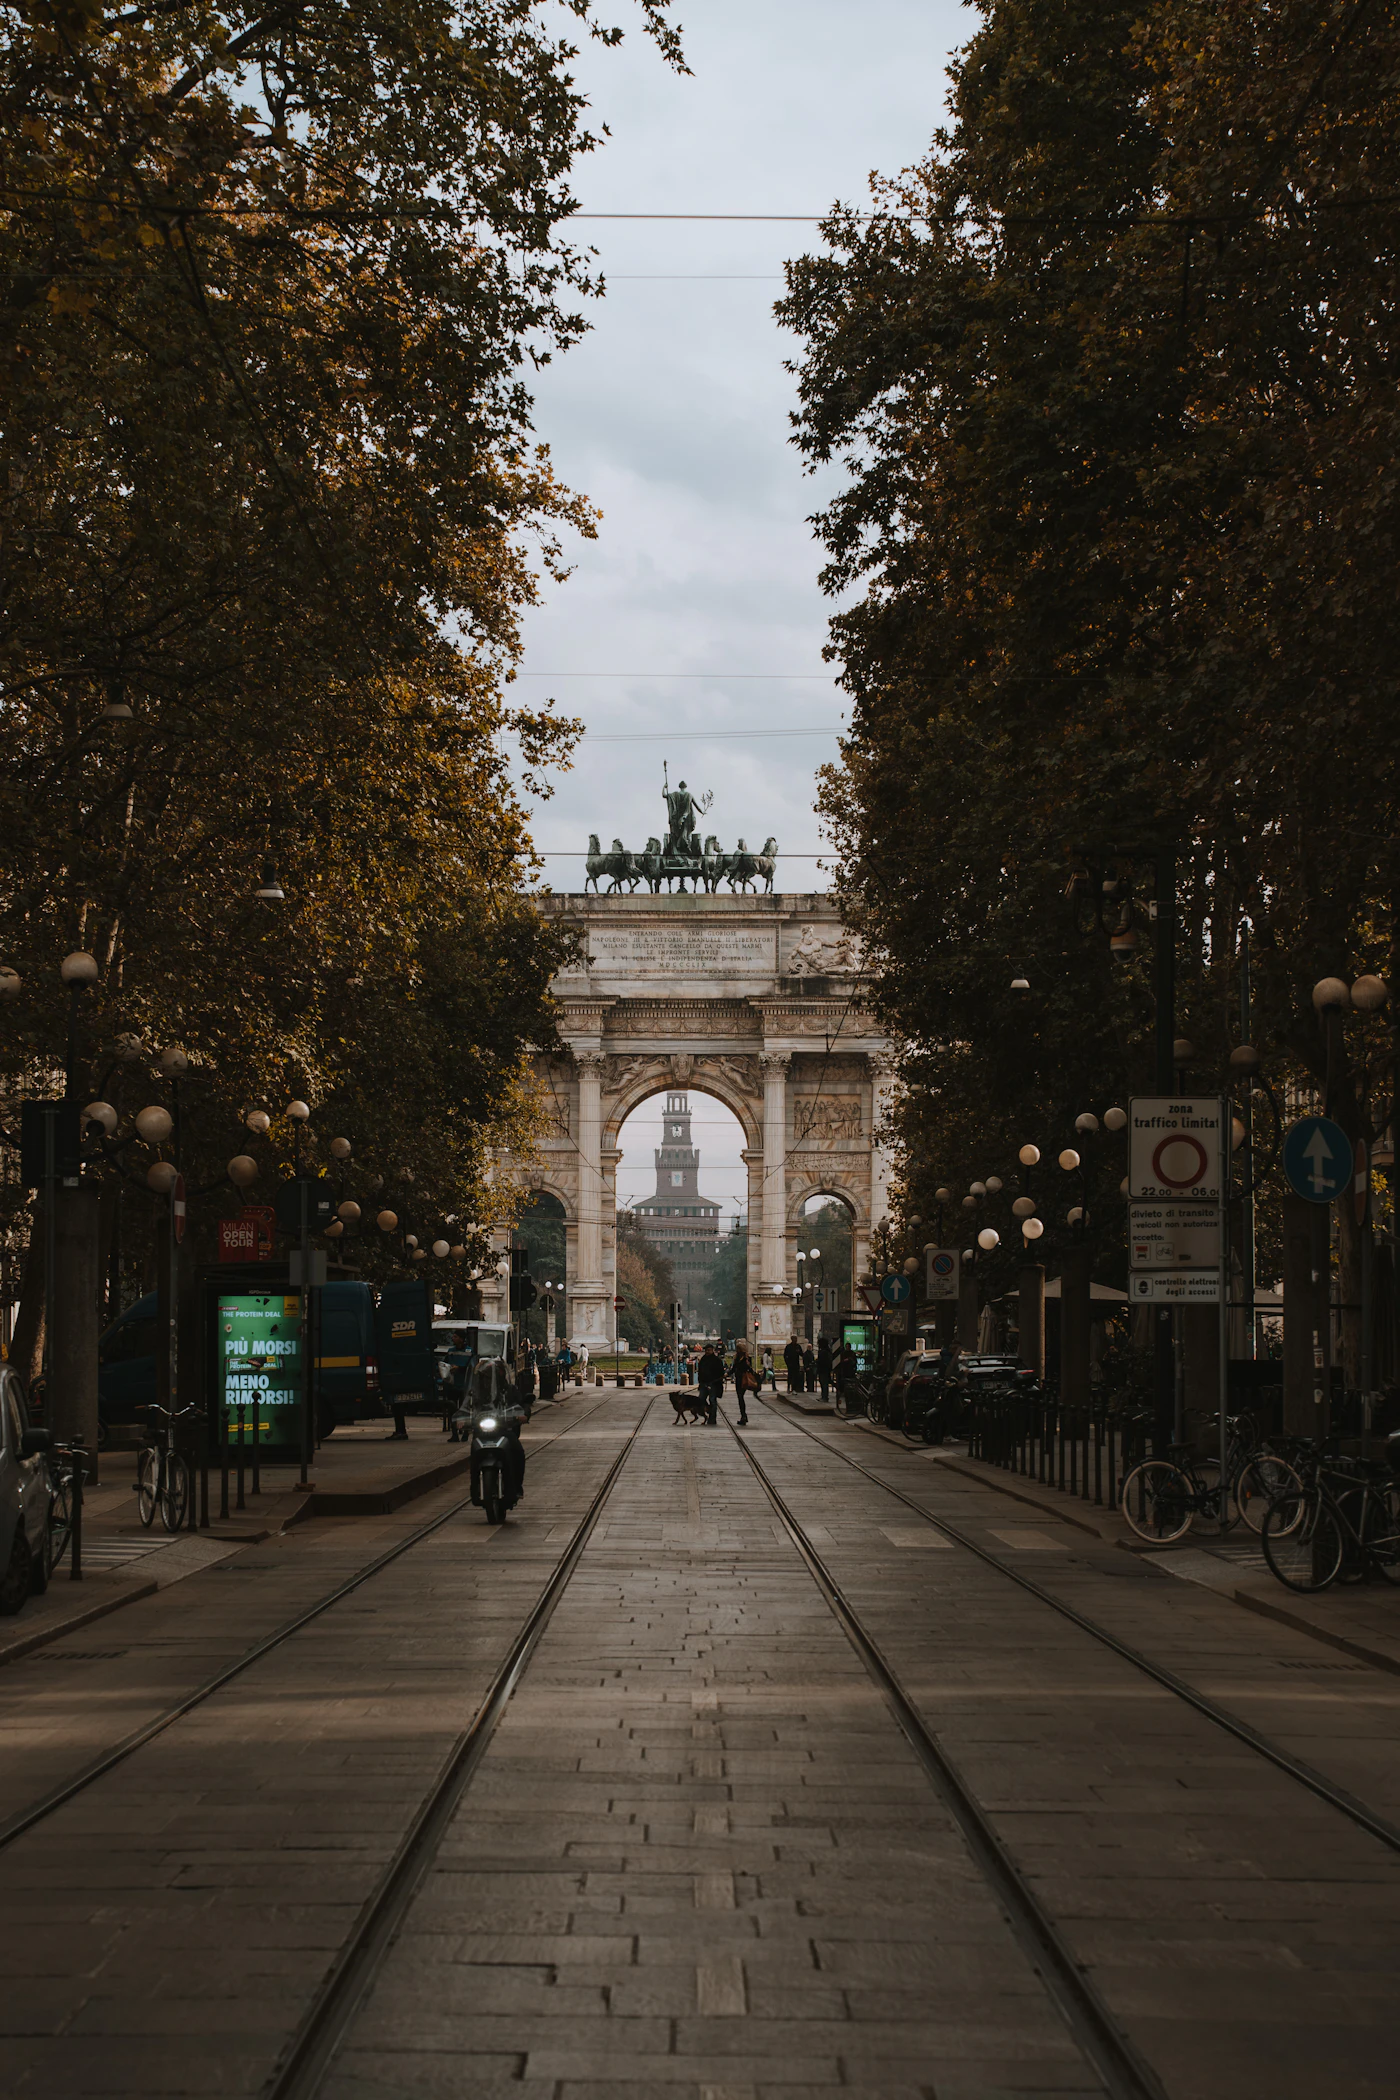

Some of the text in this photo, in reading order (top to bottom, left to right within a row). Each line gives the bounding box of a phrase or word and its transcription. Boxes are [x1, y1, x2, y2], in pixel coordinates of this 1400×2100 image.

[1169, 1105, 1193, 1114] zona
[1134, 1117, 1219, 1129] traffico limitat
[1131, 1210, 1162, 1218] divieto
[1178, 1209, 1214, 1217] transito
[222, 1222, 254, 1231] MILAN
[223, 1231, 254, 1240] OPEN
[224, 1239, 254, 1248] TOUR
[1188, 1278, 1220, 1286] elettroni
[1165, 1287, 1216, 1296] degli accessi
[391, 1321, 416, 1331] SDA
[225, 1337, 297, 1355] PIÙ MORSI
[225, 1375, 270, 1389] MENO
